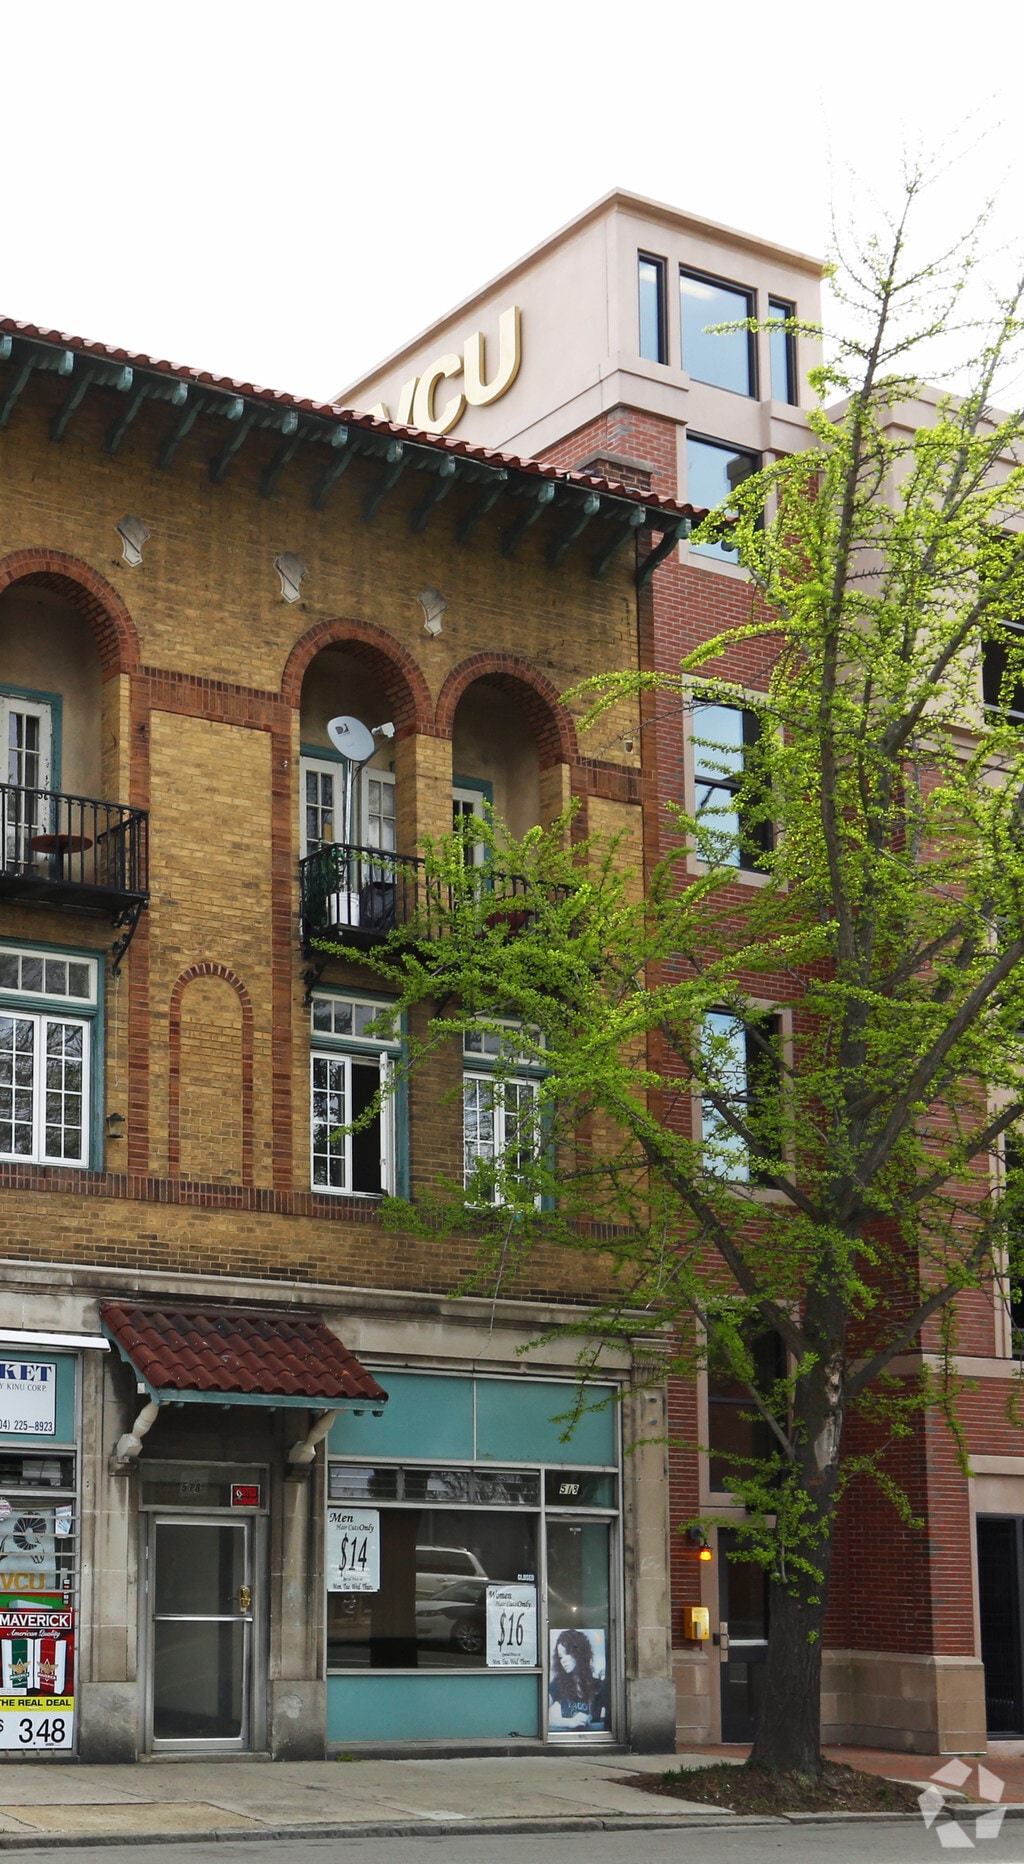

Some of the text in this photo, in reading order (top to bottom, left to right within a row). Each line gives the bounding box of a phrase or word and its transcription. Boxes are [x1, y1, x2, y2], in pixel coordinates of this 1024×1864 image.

[7, 1383, 25, 1391] KINU
[27, 1384, 47, 1392] CORP.
[559, 1483, 579, 1495] 518
[329, 1512, 354, 1523] Men
[359, 1523, 374, 1533] Only
[338, 1533, 368, 1577] $14
[0, 1571, 46, 1590] VCU
[488, 1590, 512, 1599] Women
[0, 1614, 69, 1627] MAVERICK
[7, 1629, 61, 1639] American Quality
[498, 1608, 525, 1652] $16
[18, 1699, 43, 1707] REAL
[46, 1699, 71, 1707] DEAL
[18, 1718, 66, 1745] 3.48
